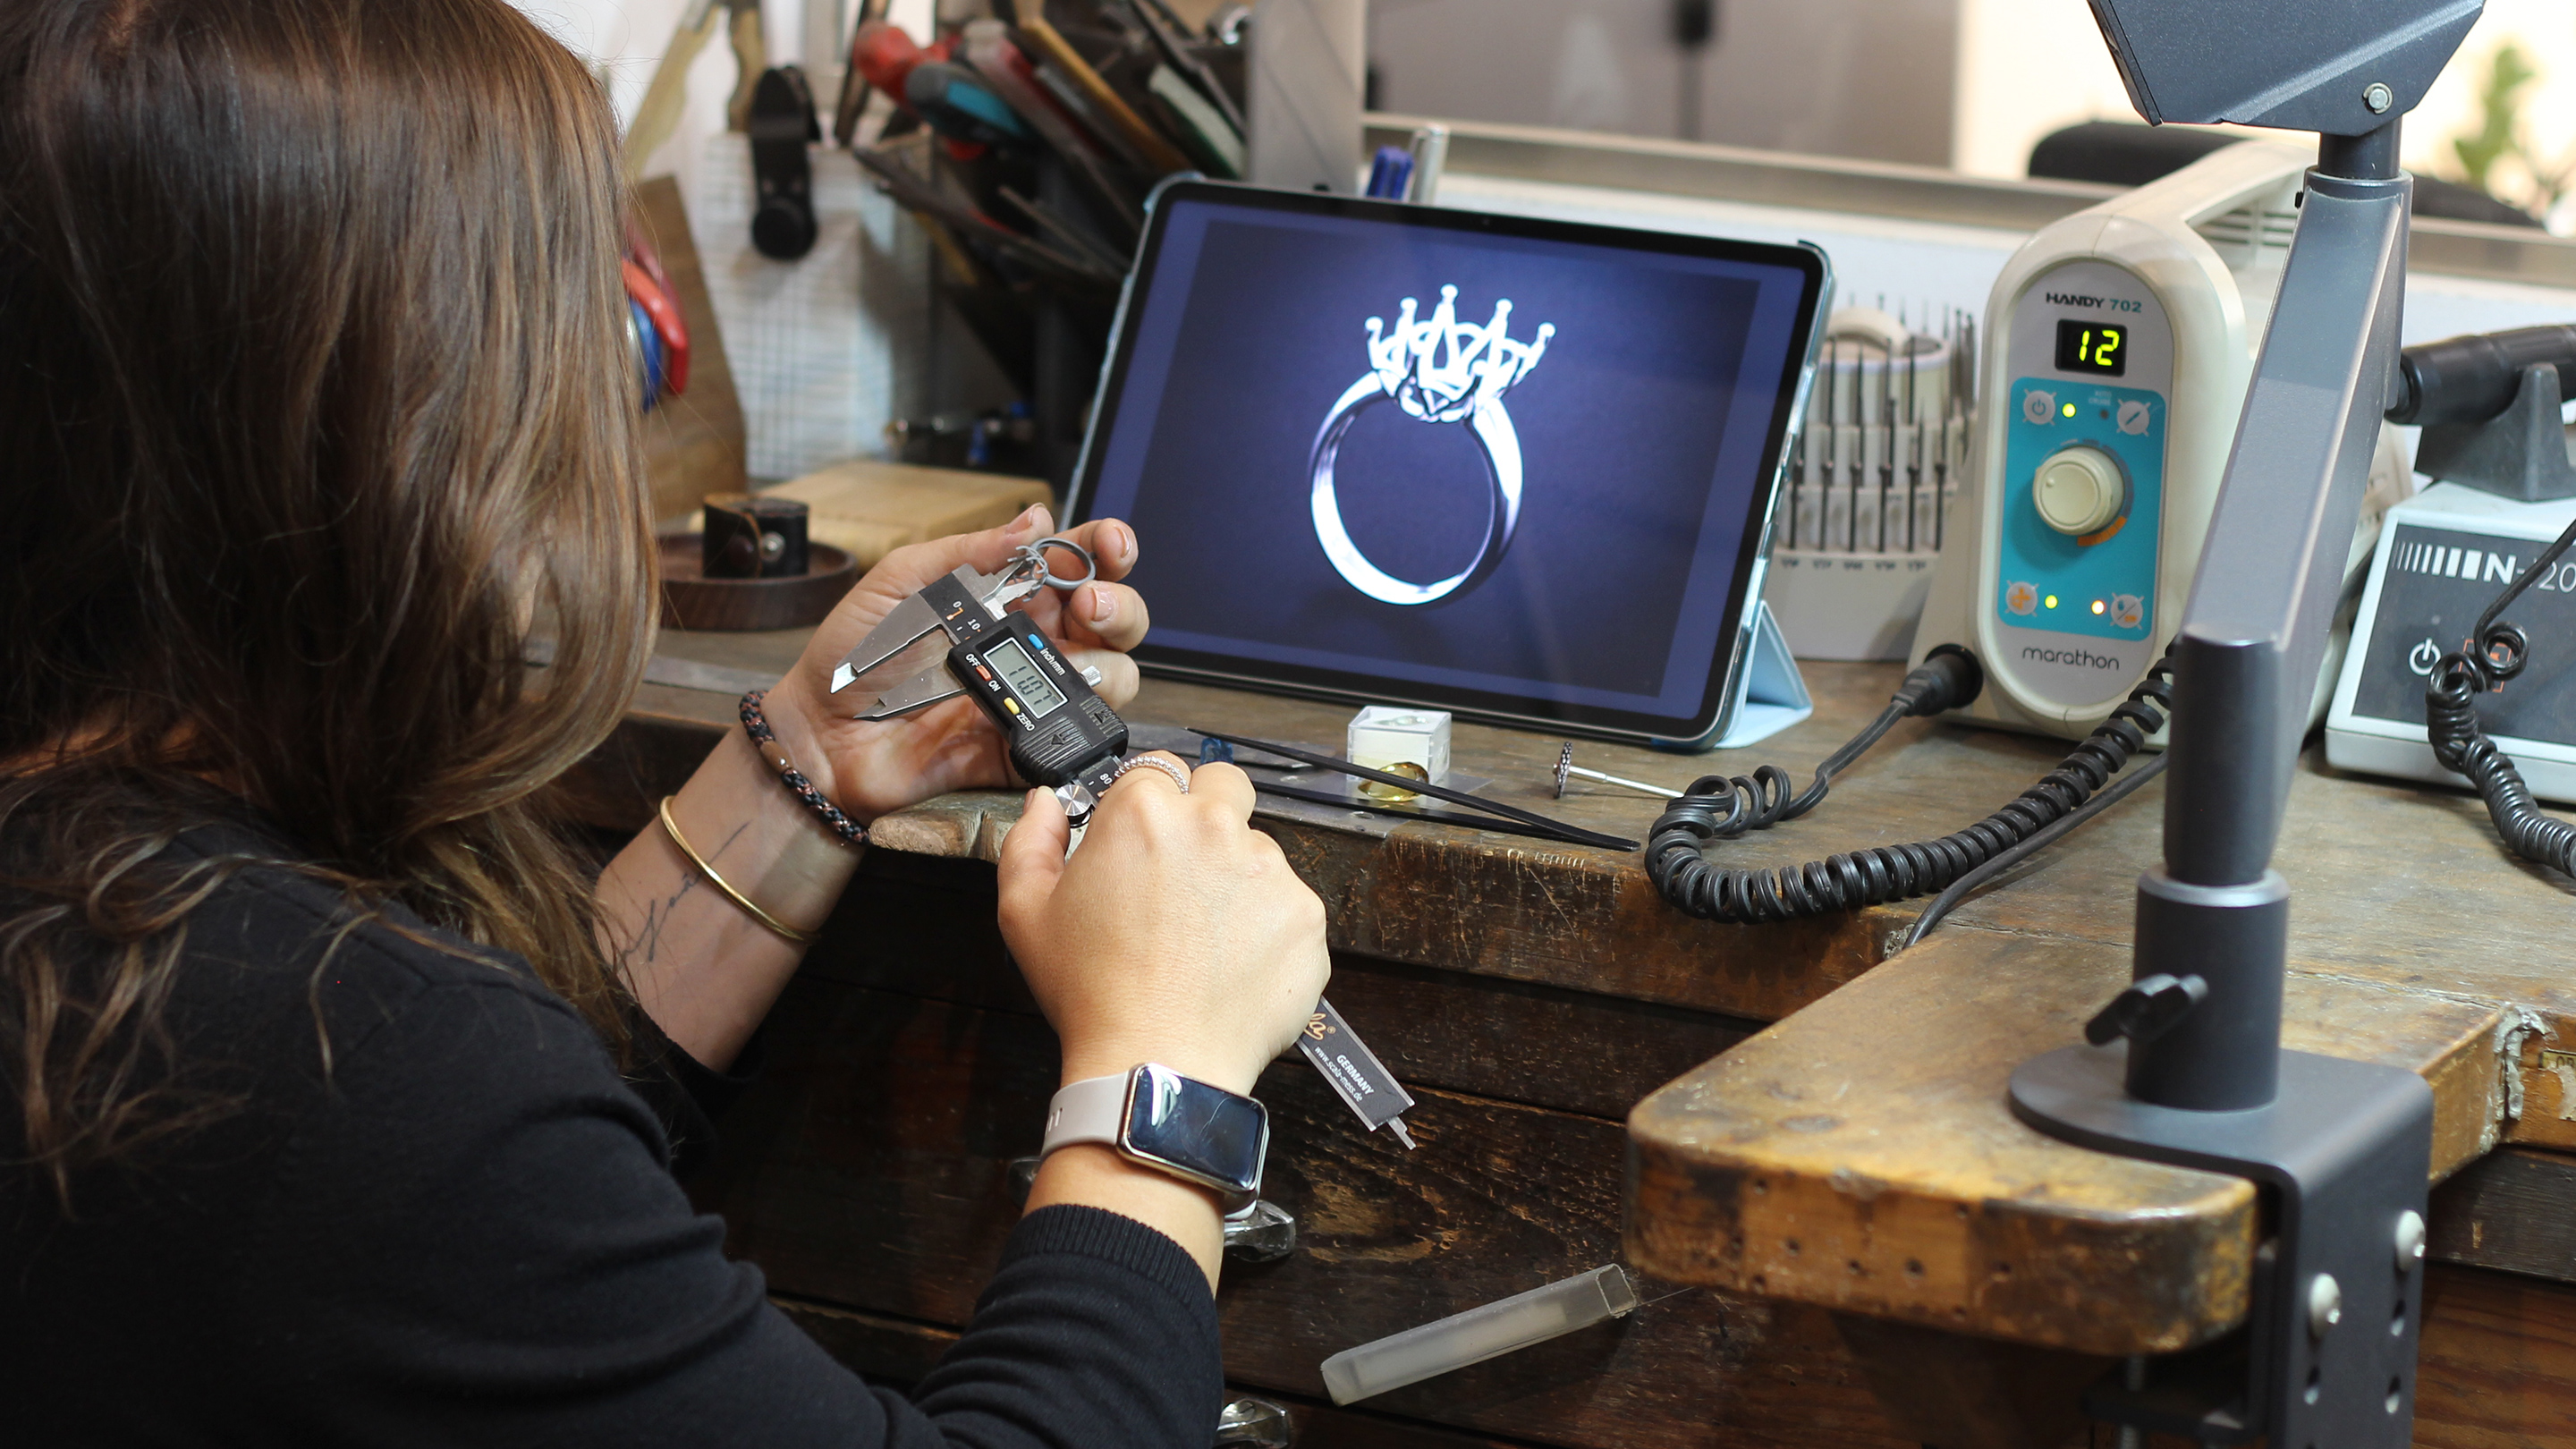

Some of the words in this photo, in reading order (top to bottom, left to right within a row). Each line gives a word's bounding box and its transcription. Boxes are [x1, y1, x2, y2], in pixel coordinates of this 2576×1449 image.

[2046, 292, 2105, 309] HANDY
[2110, 299, 2142, 313] 702
[2079, 329, 2121, 367] 12
[965, 653, 980, 666] OFF
[1039, 648, 1066, 676] inch/mm
[2021, 646, 2120, 671] marathon
[987, 679, 1002, 692] ON
[1016, 712, 1036, 732] ZERO
[1099, 773, 1113, 785] 80
[1314, 1046, 1363, 1102] www.scala-mess.de
[1336, 1055, 1375, 1095] GERMANY
